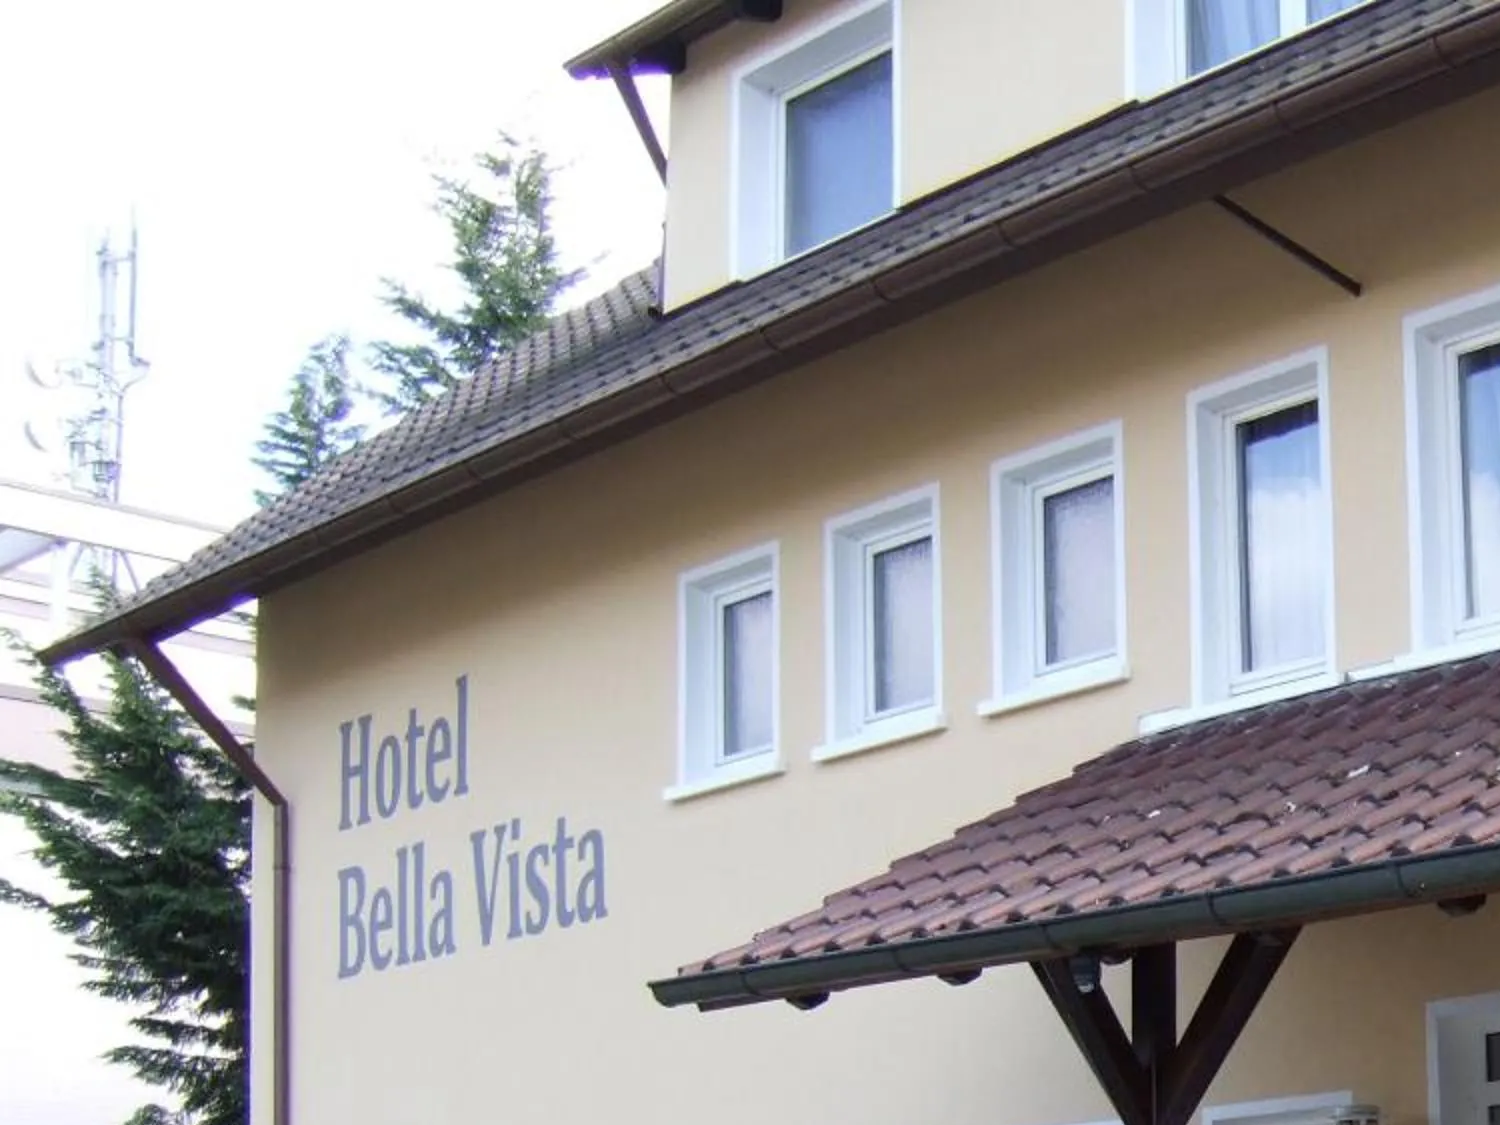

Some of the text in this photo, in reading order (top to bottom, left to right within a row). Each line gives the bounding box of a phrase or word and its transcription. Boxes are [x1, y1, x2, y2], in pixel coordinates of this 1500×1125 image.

[339, 673, 468, 830] Hotel
[338, 816, 608, 979] Bella Vista
